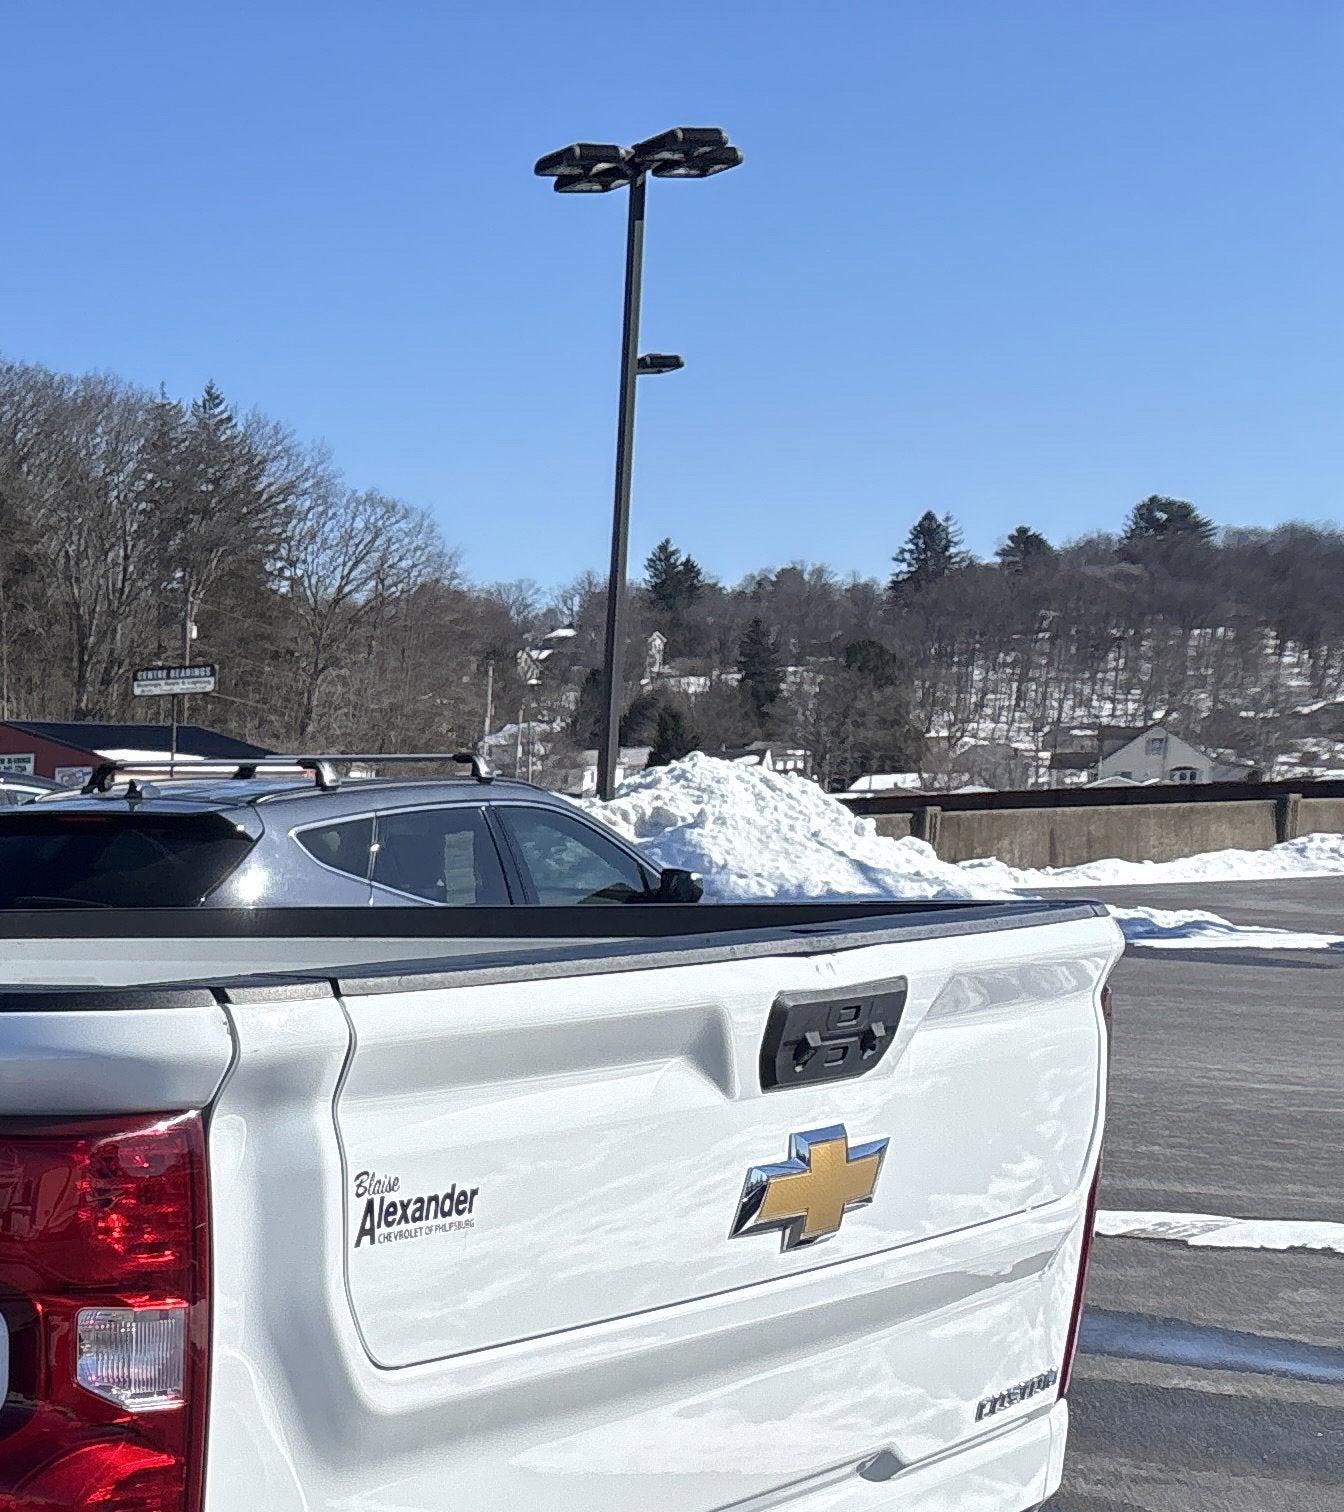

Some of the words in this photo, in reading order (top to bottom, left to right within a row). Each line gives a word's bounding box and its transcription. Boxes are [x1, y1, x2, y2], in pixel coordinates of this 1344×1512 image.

[137, 669, 167, 680] CENTRE
[170, 666, 211, 680] BEARINGS
[353, 1170, 401, 1198] Blaise
[354, 1183, 480, 1248] Alexander
[377, 1226, 424, 1245] CHEVROLET
[424, 1223, 434, 1236] OF
